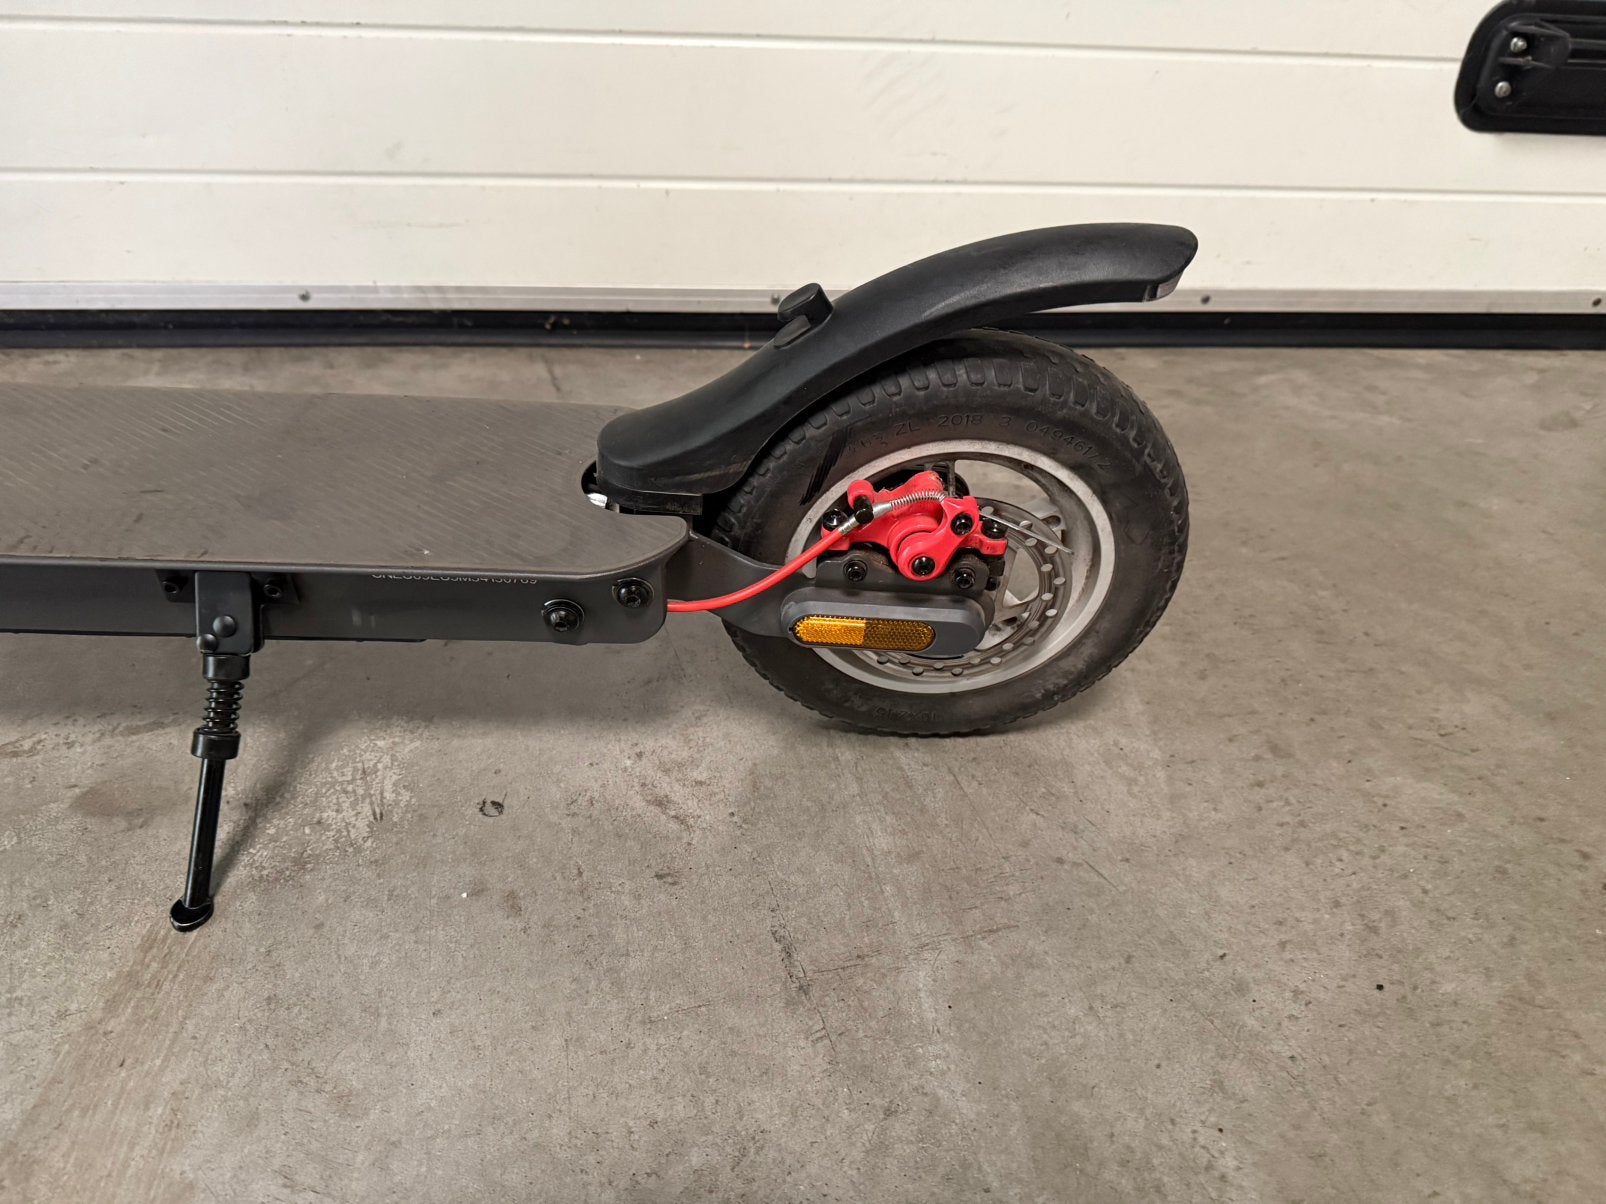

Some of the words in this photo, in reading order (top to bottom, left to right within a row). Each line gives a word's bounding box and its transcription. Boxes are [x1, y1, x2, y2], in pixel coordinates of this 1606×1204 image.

[895, 420, 920, 436] ZL
[937, 413, 983, 427] 2018
[998, 415, 1012, 427] 3
